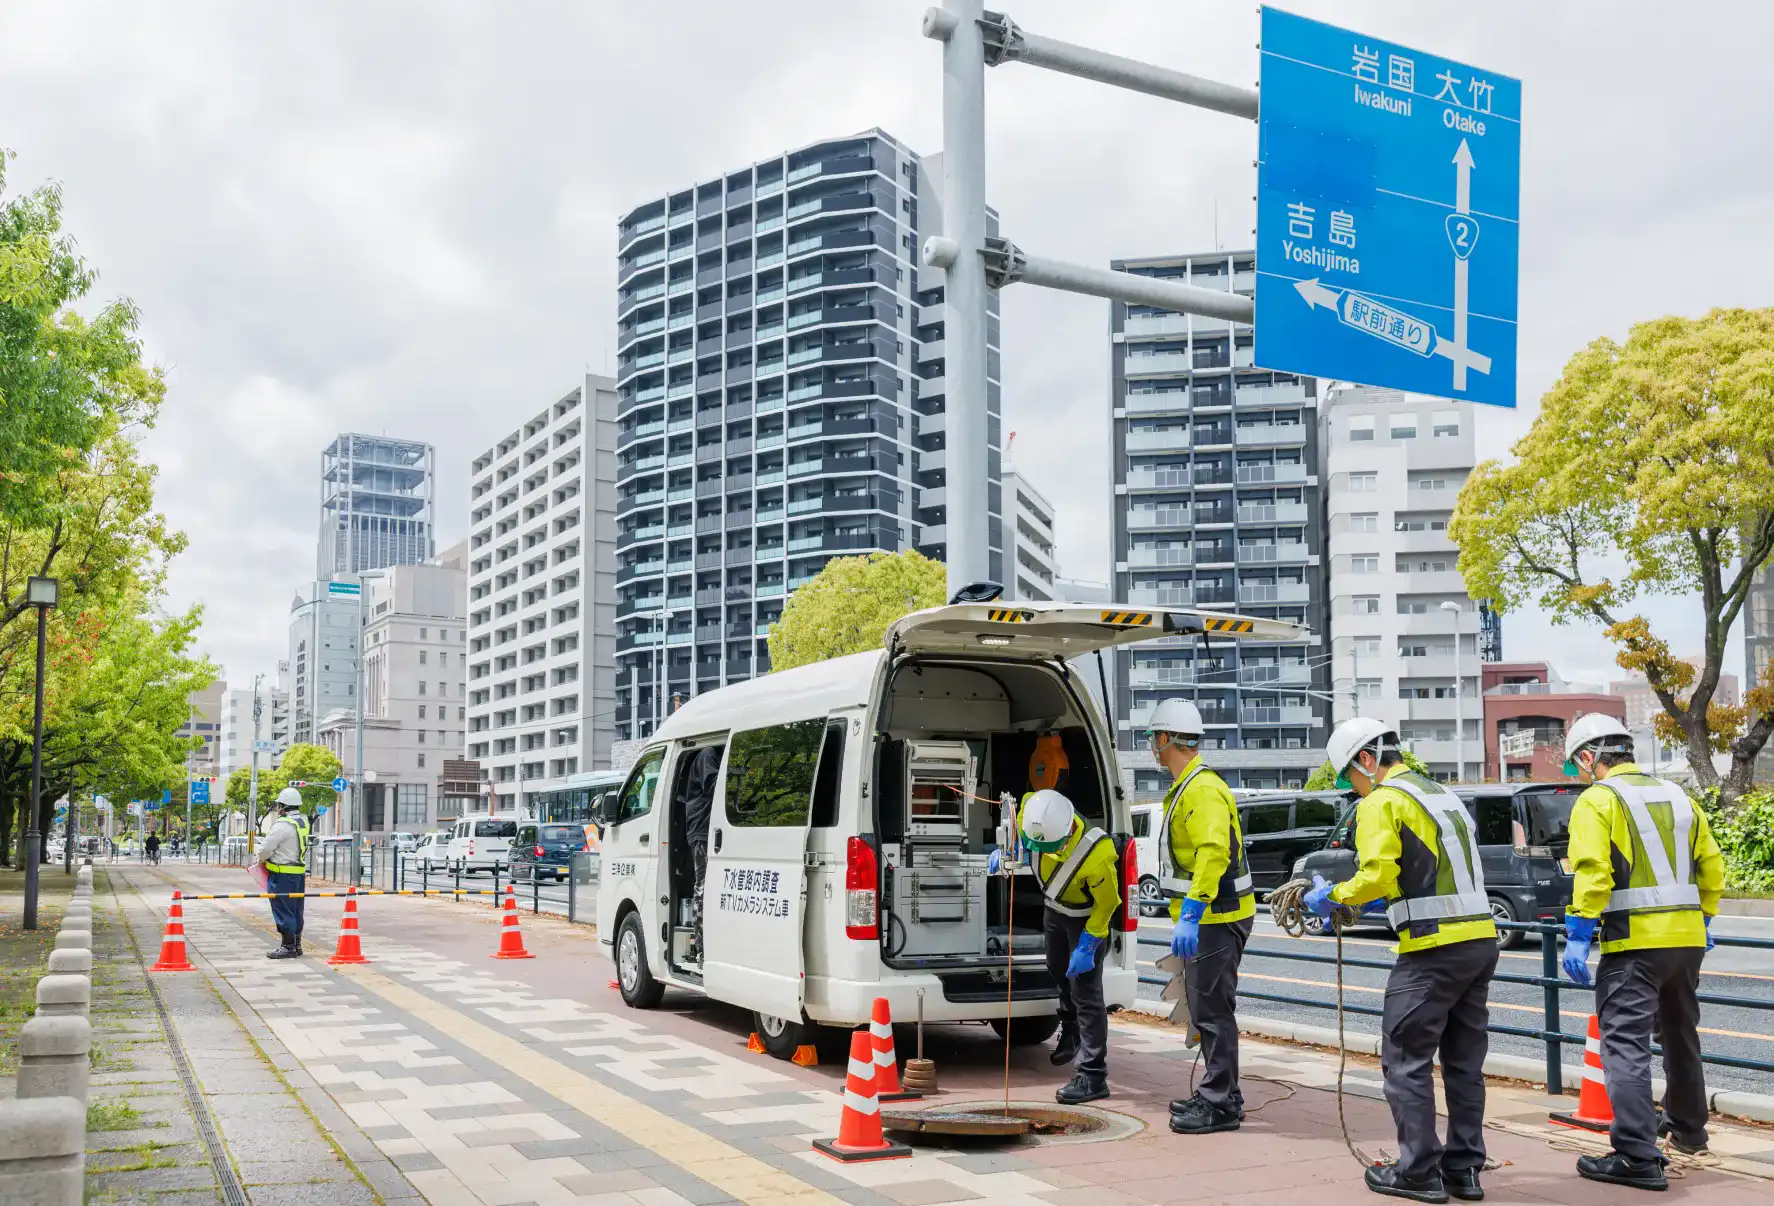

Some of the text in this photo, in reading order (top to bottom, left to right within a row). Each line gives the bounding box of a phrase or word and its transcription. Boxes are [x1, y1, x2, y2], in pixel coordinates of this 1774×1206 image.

[1352, 44, 1495, 114] 岩国 大竹
[1354, 83, 1486, 136] Iwakuni Otake
[1287, 202, 1356, 249] 吉島
[1455, 222, 1469, 247] 2
[1282, 240, 1360, 274] Yoshijima
[1349, 300, 1422, 345] 駅前通り
[724, 868, 780, 893] 下水管路内調査
